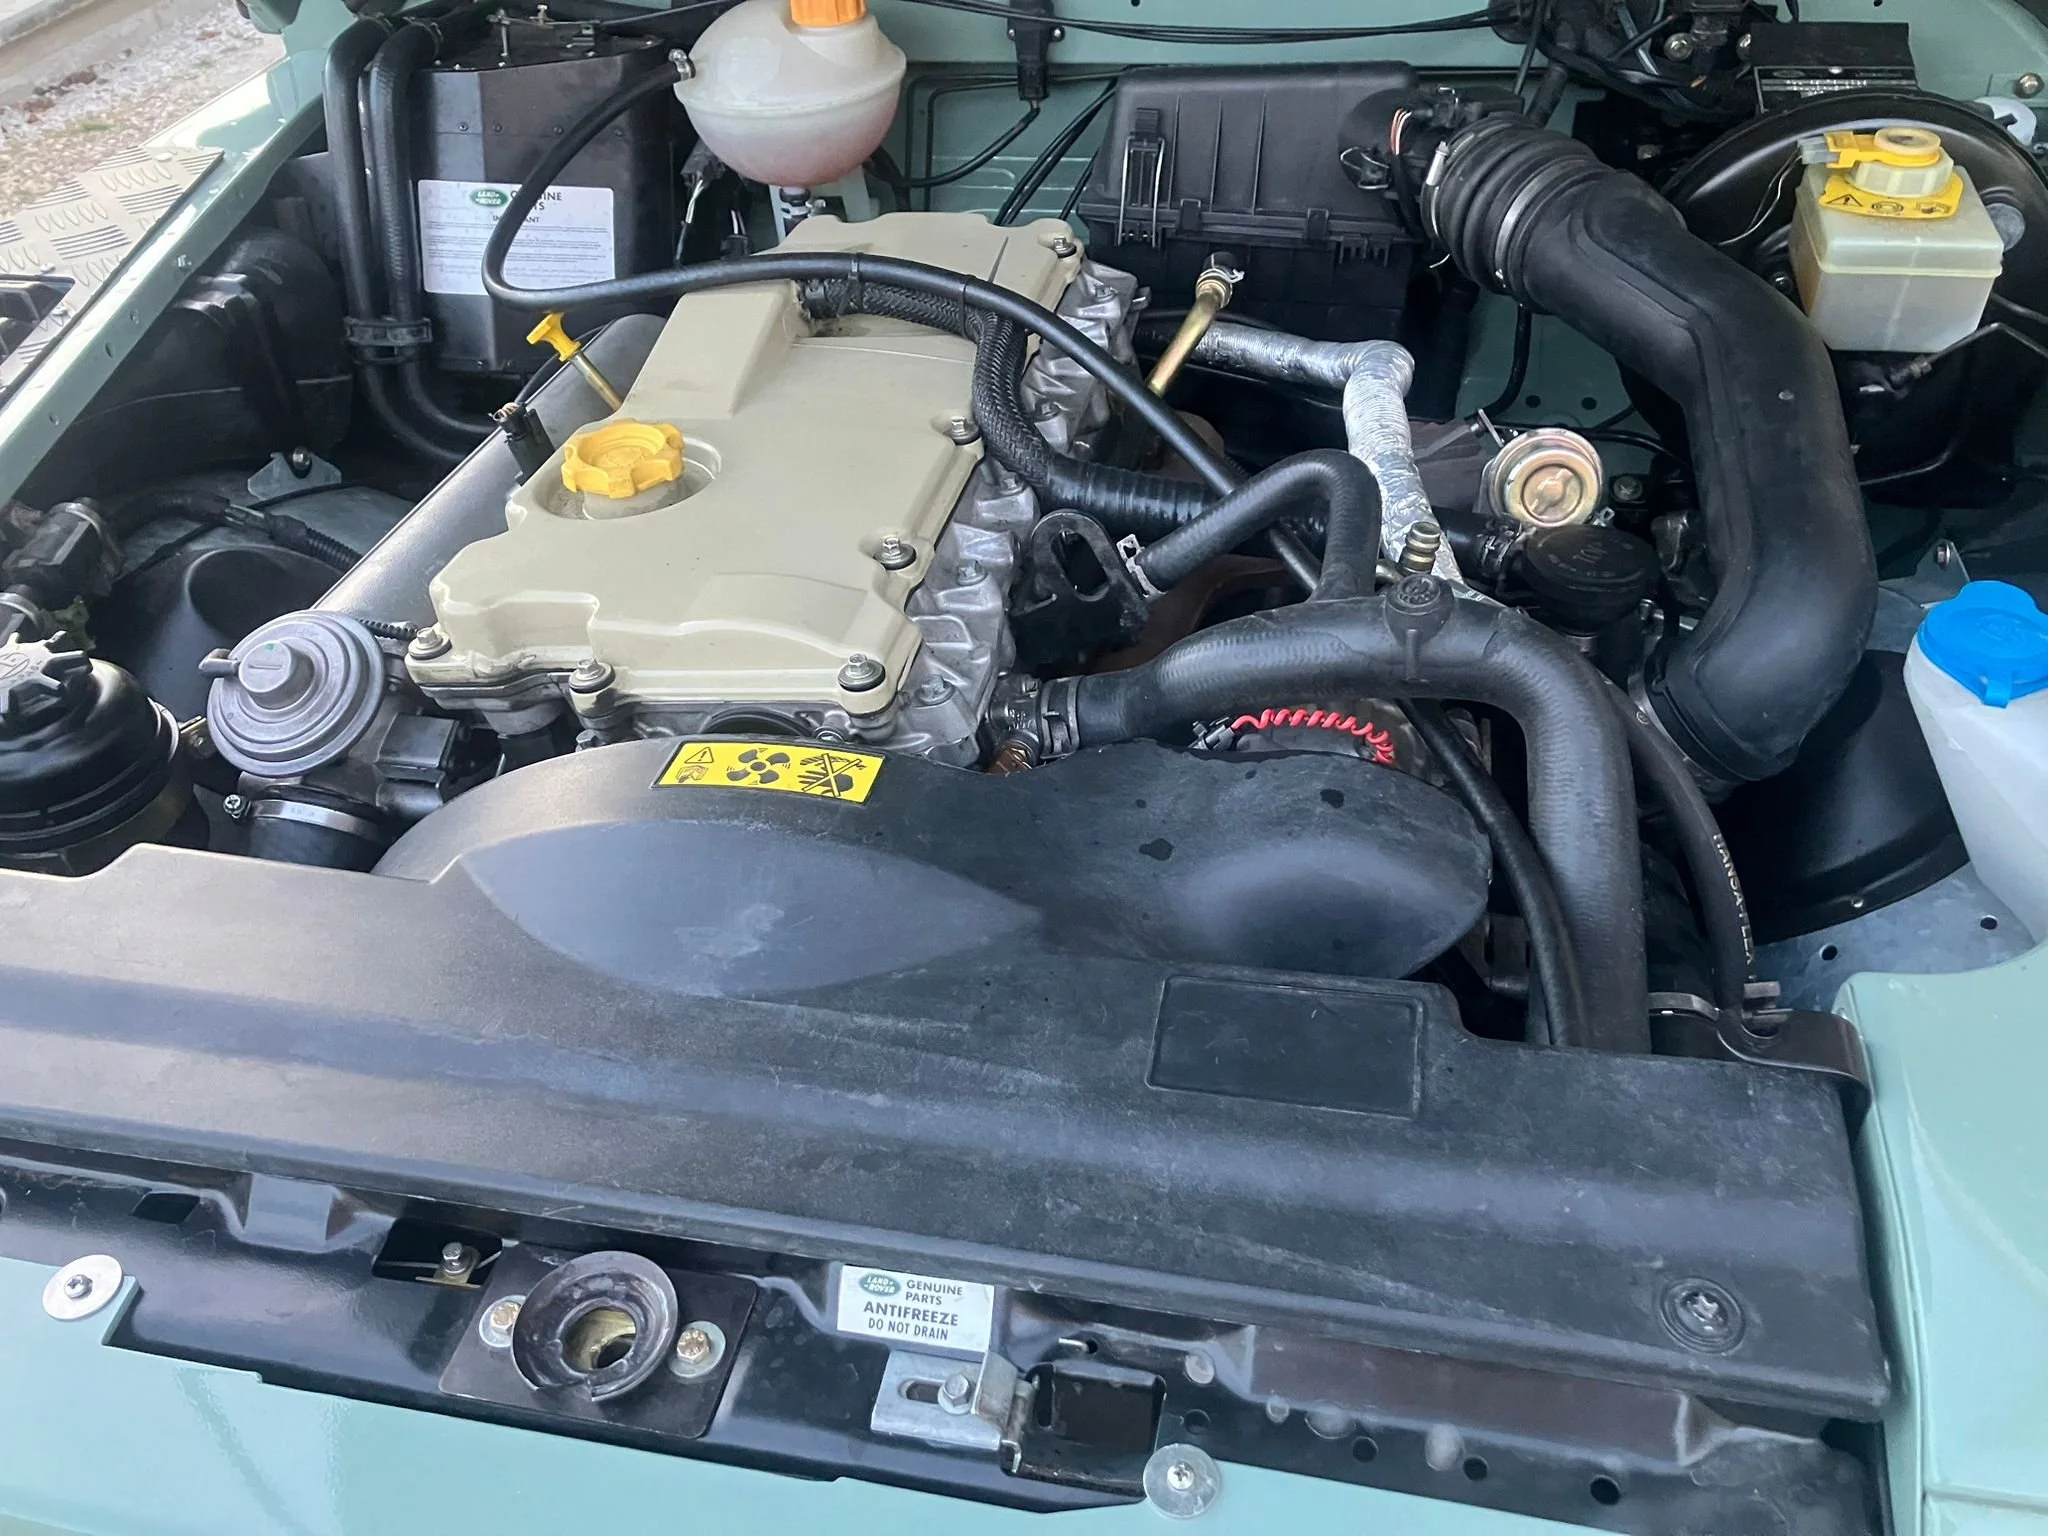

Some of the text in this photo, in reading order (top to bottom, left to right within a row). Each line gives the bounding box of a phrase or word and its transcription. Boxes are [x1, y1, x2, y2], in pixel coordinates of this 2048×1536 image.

[867, 1276, 889, 1285] LAND
[906, 1279, 963, 1296] GENUINE
[868, 1284, 896, 1294] ROVER
[905, 1291, 943, 1306] PARTS
[863, 1301, 959, 1327] ANTIFREEZE
[868, 1317, 949, 1341] DO NOT DRAIN
